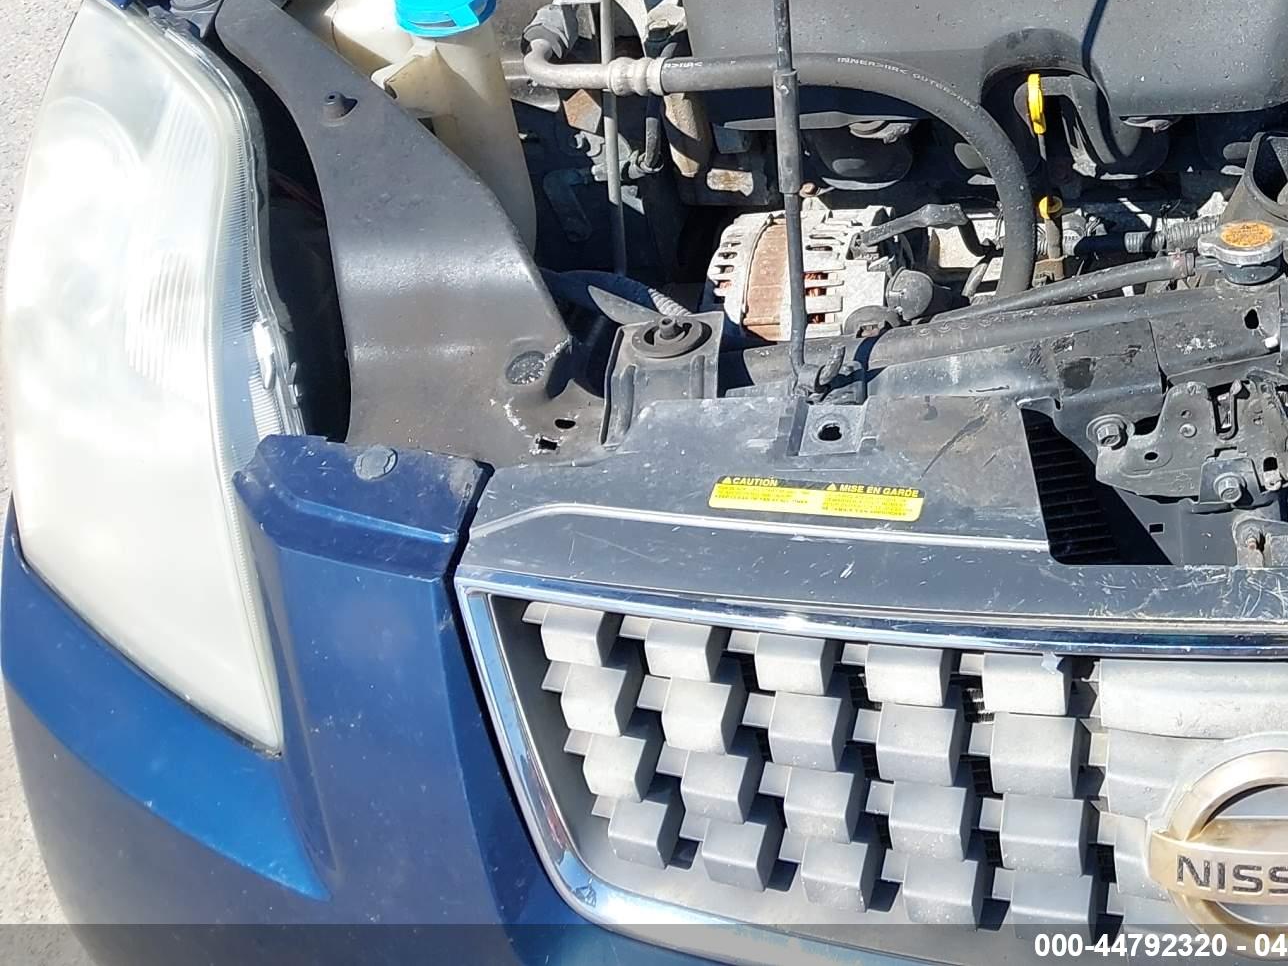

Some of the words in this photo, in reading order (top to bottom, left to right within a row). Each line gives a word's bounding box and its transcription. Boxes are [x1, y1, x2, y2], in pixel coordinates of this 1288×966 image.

[733, 477, 778, 487] CAUTION
[839, 484, 865, 493] MISE
[867, 486, 881, 495] EN
[884, 487, 919, 498] GARDE
